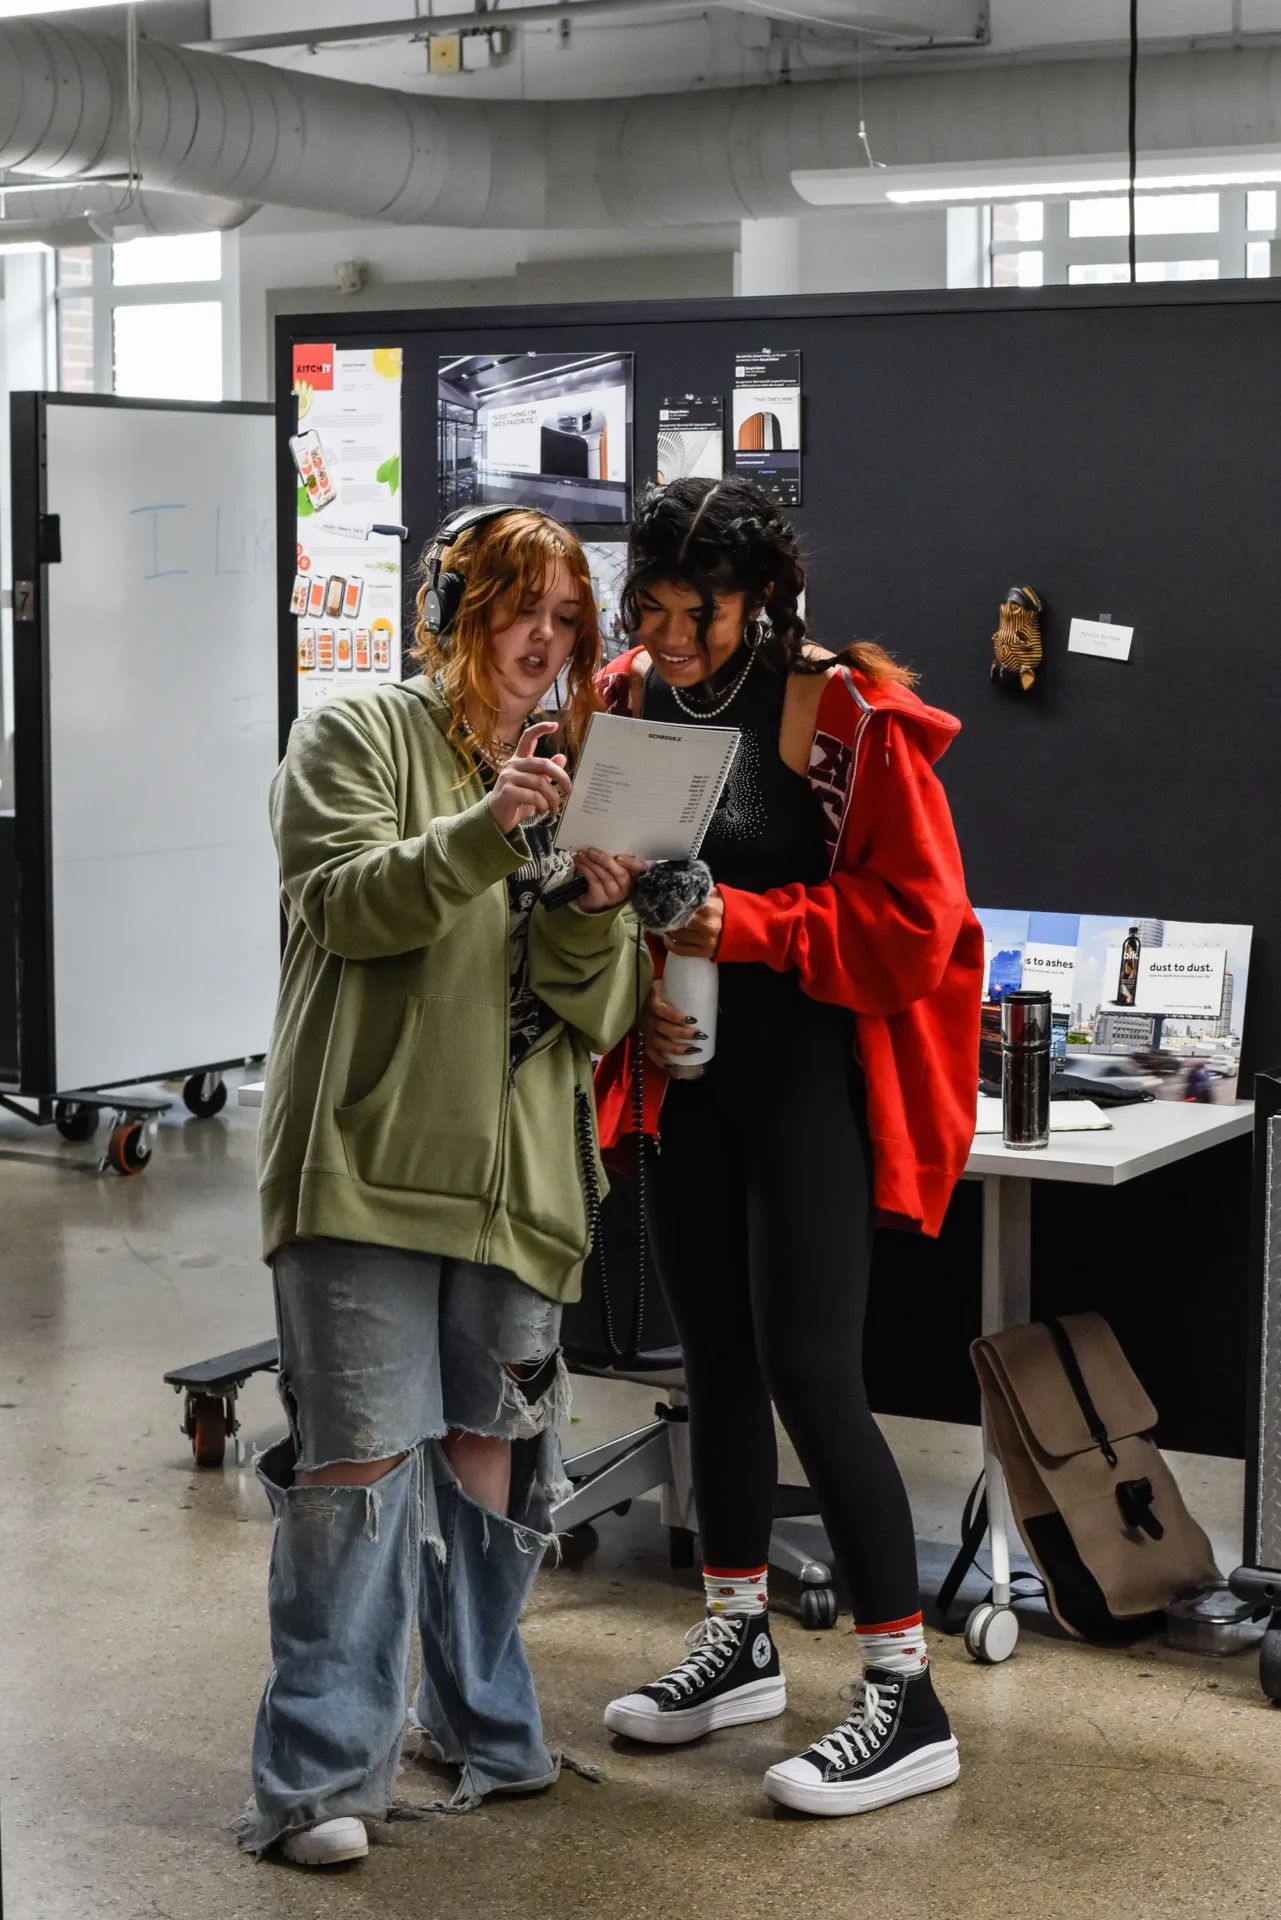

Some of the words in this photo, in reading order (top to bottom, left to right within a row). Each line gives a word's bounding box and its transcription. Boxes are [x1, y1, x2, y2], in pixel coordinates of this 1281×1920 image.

[296, 363, 332, 374] KITCHIT
[20, 591, 30, 612] 7
[647, 733, 683, 743] SCHEDULE
[1033, 957, 1044, 966] to
[1045, 958, 1076, 969] ashes.
[1149, 962, 1172, 972] dust
[1174, 963, 1185, 972] to
[1187, 962, 1214, 972] dust.
